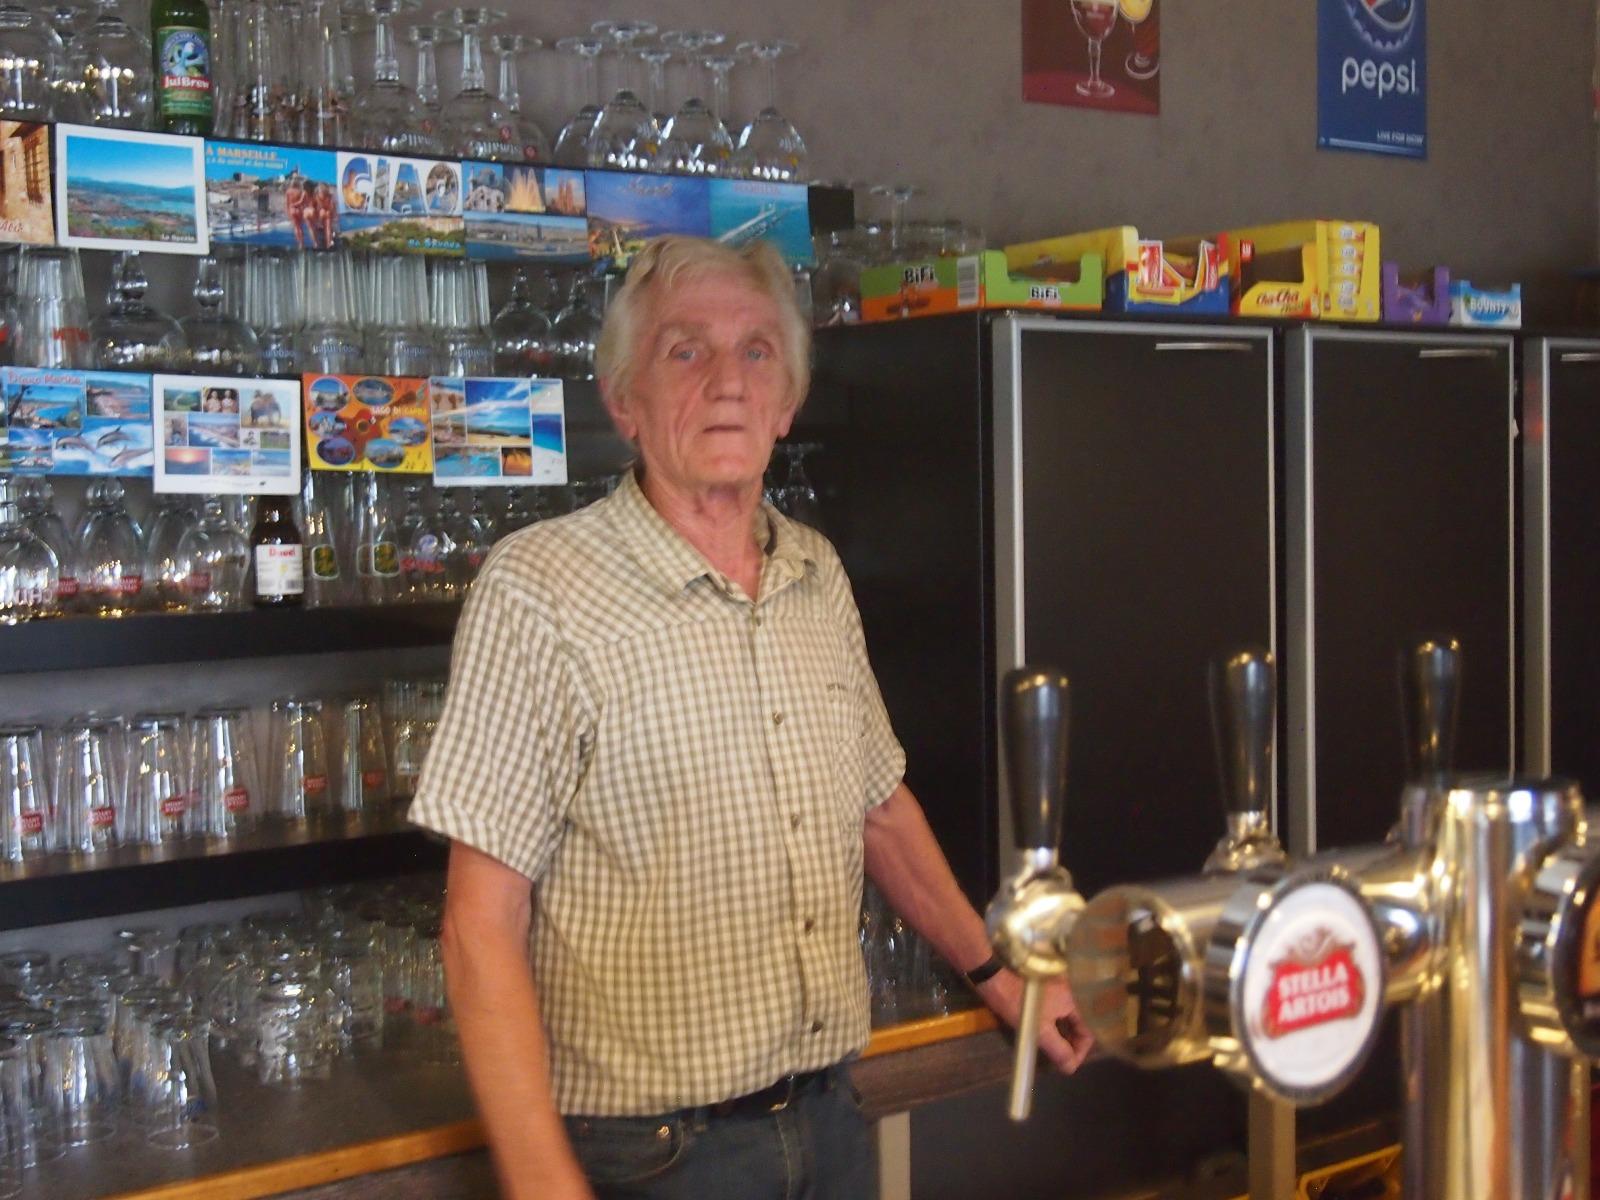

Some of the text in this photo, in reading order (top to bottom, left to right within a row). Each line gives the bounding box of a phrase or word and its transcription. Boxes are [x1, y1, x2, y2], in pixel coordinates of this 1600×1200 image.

[1341, 57, 1416, 98] pepsi
[1279, 961, 1348, 1000] STELLA
[1278, 986, 1350, 1024] ARTOIS
